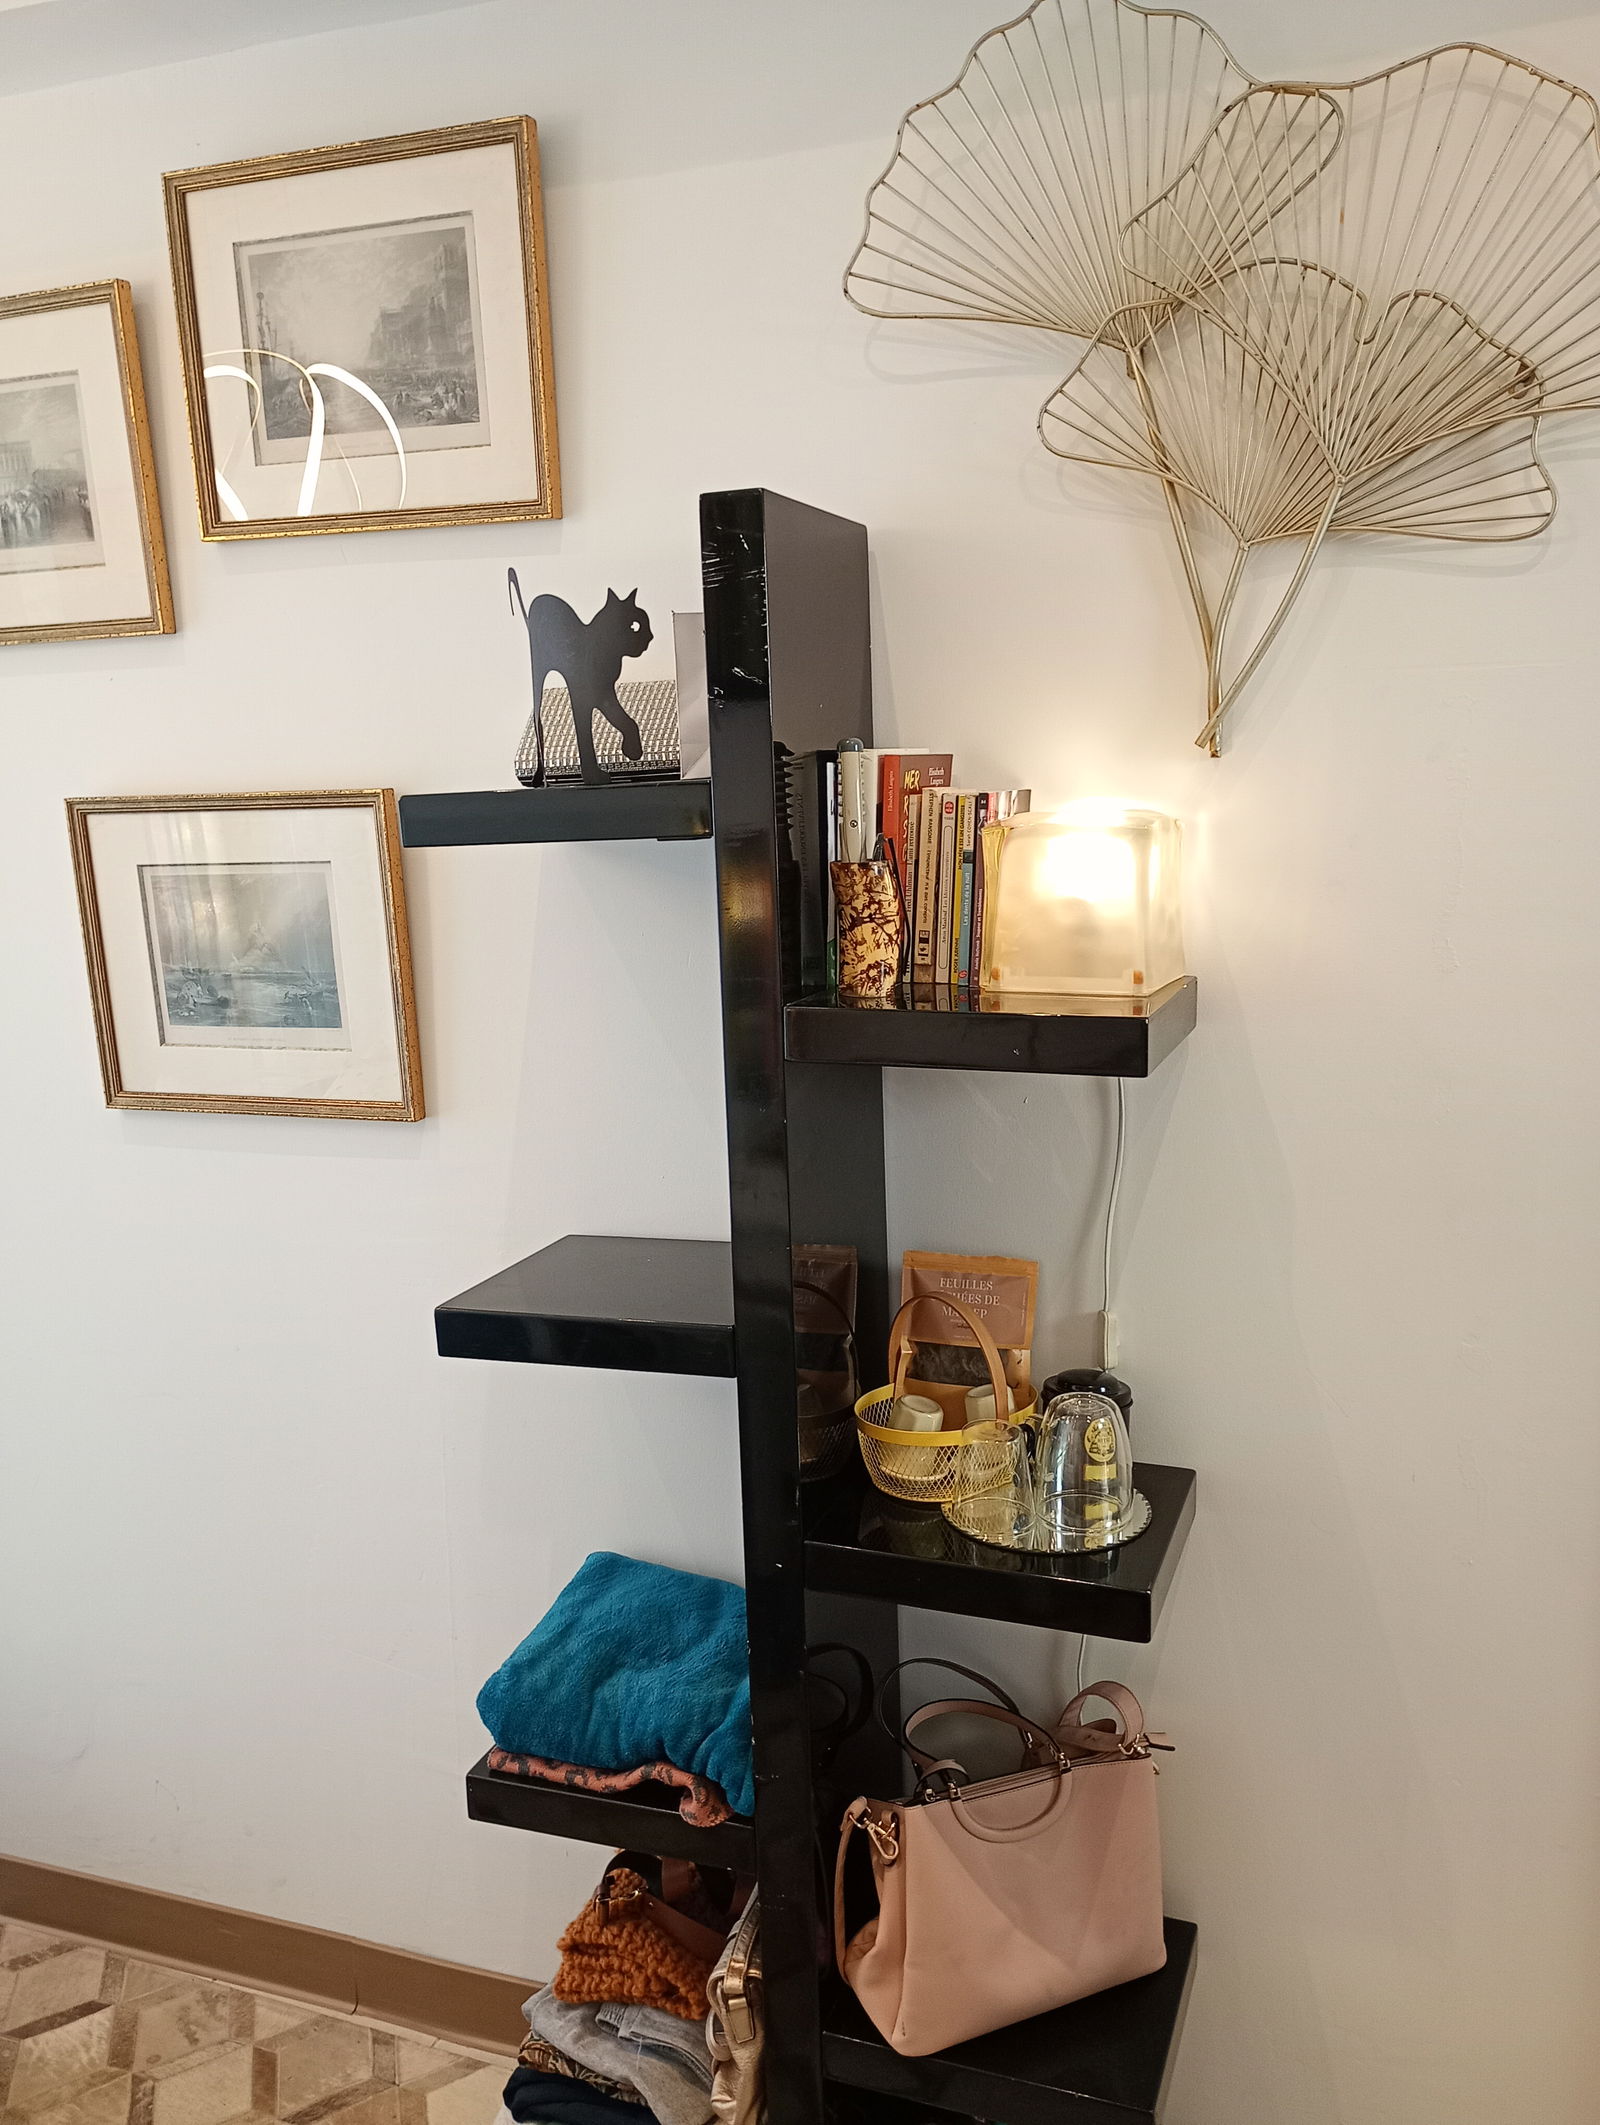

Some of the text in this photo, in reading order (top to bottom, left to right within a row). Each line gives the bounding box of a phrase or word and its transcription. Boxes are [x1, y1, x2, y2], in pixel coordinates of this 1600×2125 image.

[963, 891, 969, 899] de
[940, 1278, 993, 1290] FEUILLES
[984, 1295, 1000, 1305] DE
